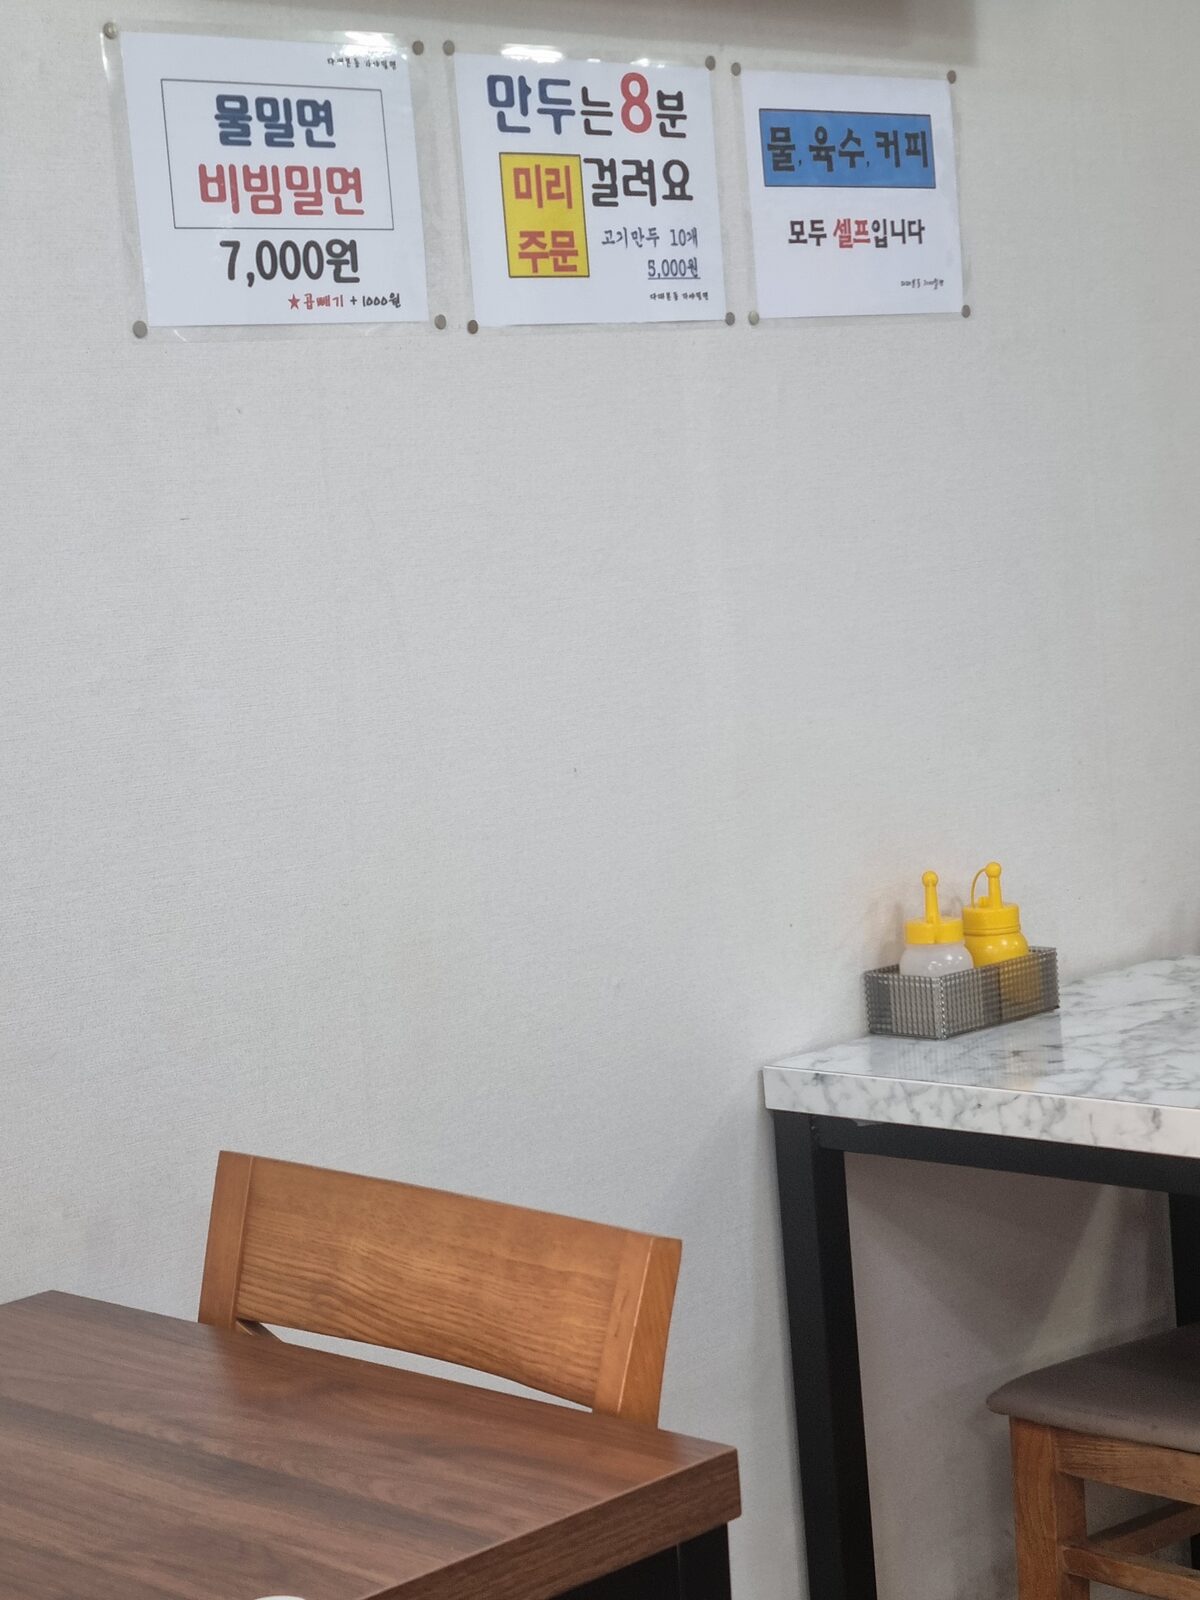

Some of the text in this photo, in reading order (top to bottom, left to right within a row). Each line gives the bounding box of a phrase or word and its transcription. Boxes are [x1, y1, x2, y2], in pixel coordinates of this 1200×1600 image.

[214, 93, 336, 149] 물밀면
[875, 130, 929, 168] 커피
[198, 163, 365, 216] 비빔밀면
[512, 164, 573, 209] 미리
[583, 158, 694, 207] 걸려요
[518, 230, 579, 274] 주문
[601, 227, 698, 248] 고기만두 10개
[788, 218, 925, 248] 모두 셀프입니다
[219, 239, 360, 287] 7,000원
[648, 257, 698, 278] 5,000원
